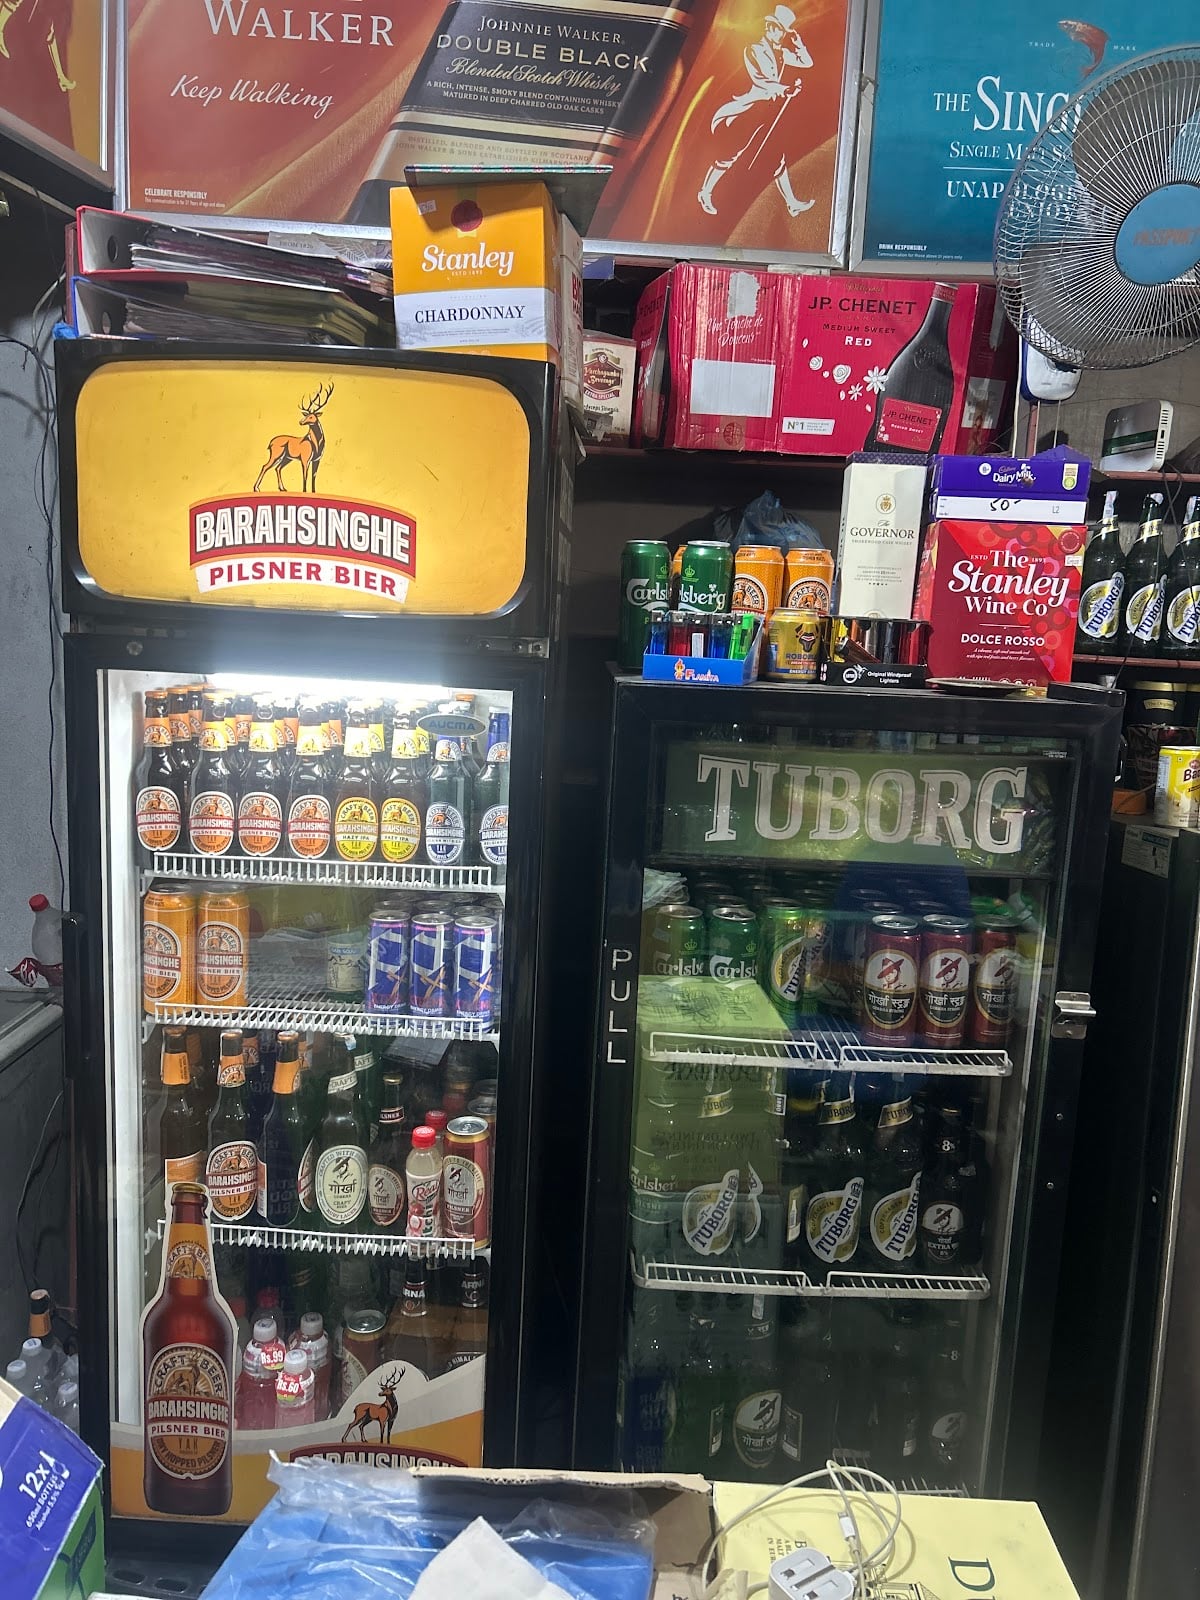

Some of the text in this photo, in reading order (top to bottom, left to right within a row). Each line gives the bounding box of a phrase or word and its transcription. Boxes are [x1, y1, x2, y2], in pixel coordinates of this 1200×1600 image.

[205, 0, 394, 47] WALKER
[478, 16, 621, 44] JOHNNIE WALKER
[436, 34, 650, 73] DOUBLE BLACK
[446, 57, 622, 98] Blended Scotch Whisky
[171, 74, 334, 120] Keep Walking
[433, 81, 454, 91] RICH,
[456, 84, 490, 95] INTENSE,
[491, 88, 518, 98] SMOKY
[518, 91, 543, 100] BLEND
[544, 93, 591, 105] CONTAINING
[592, 99, 622, 108] WHISKY
[442, 90, 478, 101] MATURED
[489, 96, 509, 104] DEEP
[510, 98, 546, 108] CHARRED
[547, 102, 562, 110] OLD
[563, 103, 579, 112] OAK
[580, 105, 605, 114] CASKS
[933, 91, 971, 112] THE
[551, 152, 589, 162] SCOTLAND
[949, 141, 1000, 159] SINGLE
[144, 187, 208, 200] CELEBRATE RESPONSIBLY
[421, 242, 515, 277] Stanley
[414, 305, 526, 324] CHARDONNAY
[808, 296, 917, 315] JP. CHENET
[754, 314, 763, 327] de
[822, 323, 896, 334] MEDIUM SWEET
[845, 336, 873, 347] RED
[898, 412, 933, 426] CHENET
[993, 472, 1016, 484] Dairy
[195, 504, 411, 565] BARAHSINGHE
[850, 526, 915, 539] GOVERNOR
[990, 549, 1029, 569] The
[209, 561, 396, 597] PILSNER BIER
[948, 559, 1070, 607] Stanley
[964, 595, 1048, 618] Wine Co
[1086, 586, 1121, 634] TUBORG
[961, 633, 1045, 647] DOLCE ROSSO
[340, 804, 357, 819] CRAFT
[697, 753, 1028, 854] TUBORG
[157, 933, 172, 952] BEER
[222, 932, 237, 950] BEER
[606, 948, 633, 1064] PULL
[328, 1178, 358, 1194] गोर्खा
[692, 1189, 736, 1248] TUBORG
[815, 1197, 857, 1256] TUBORG
[166, 1246, 212, 1276] CRAFT BEER
[260, 1350, 284, 1365] Rs.99
[154, 1354, 223, 1392] CRAFT BEER
[276, 1378, 300, 1394] Rs.60
[148, 1400, 229, 1424] BARAHSINGHE
[151, 1424, 226, 1439] PILSNER BIER
[167, 1440, 221, 1468] HOPPED PILSNER
[18, 1463, 51, 1499] 12x
[37, 1473, 59, 1506] BOTTLES
